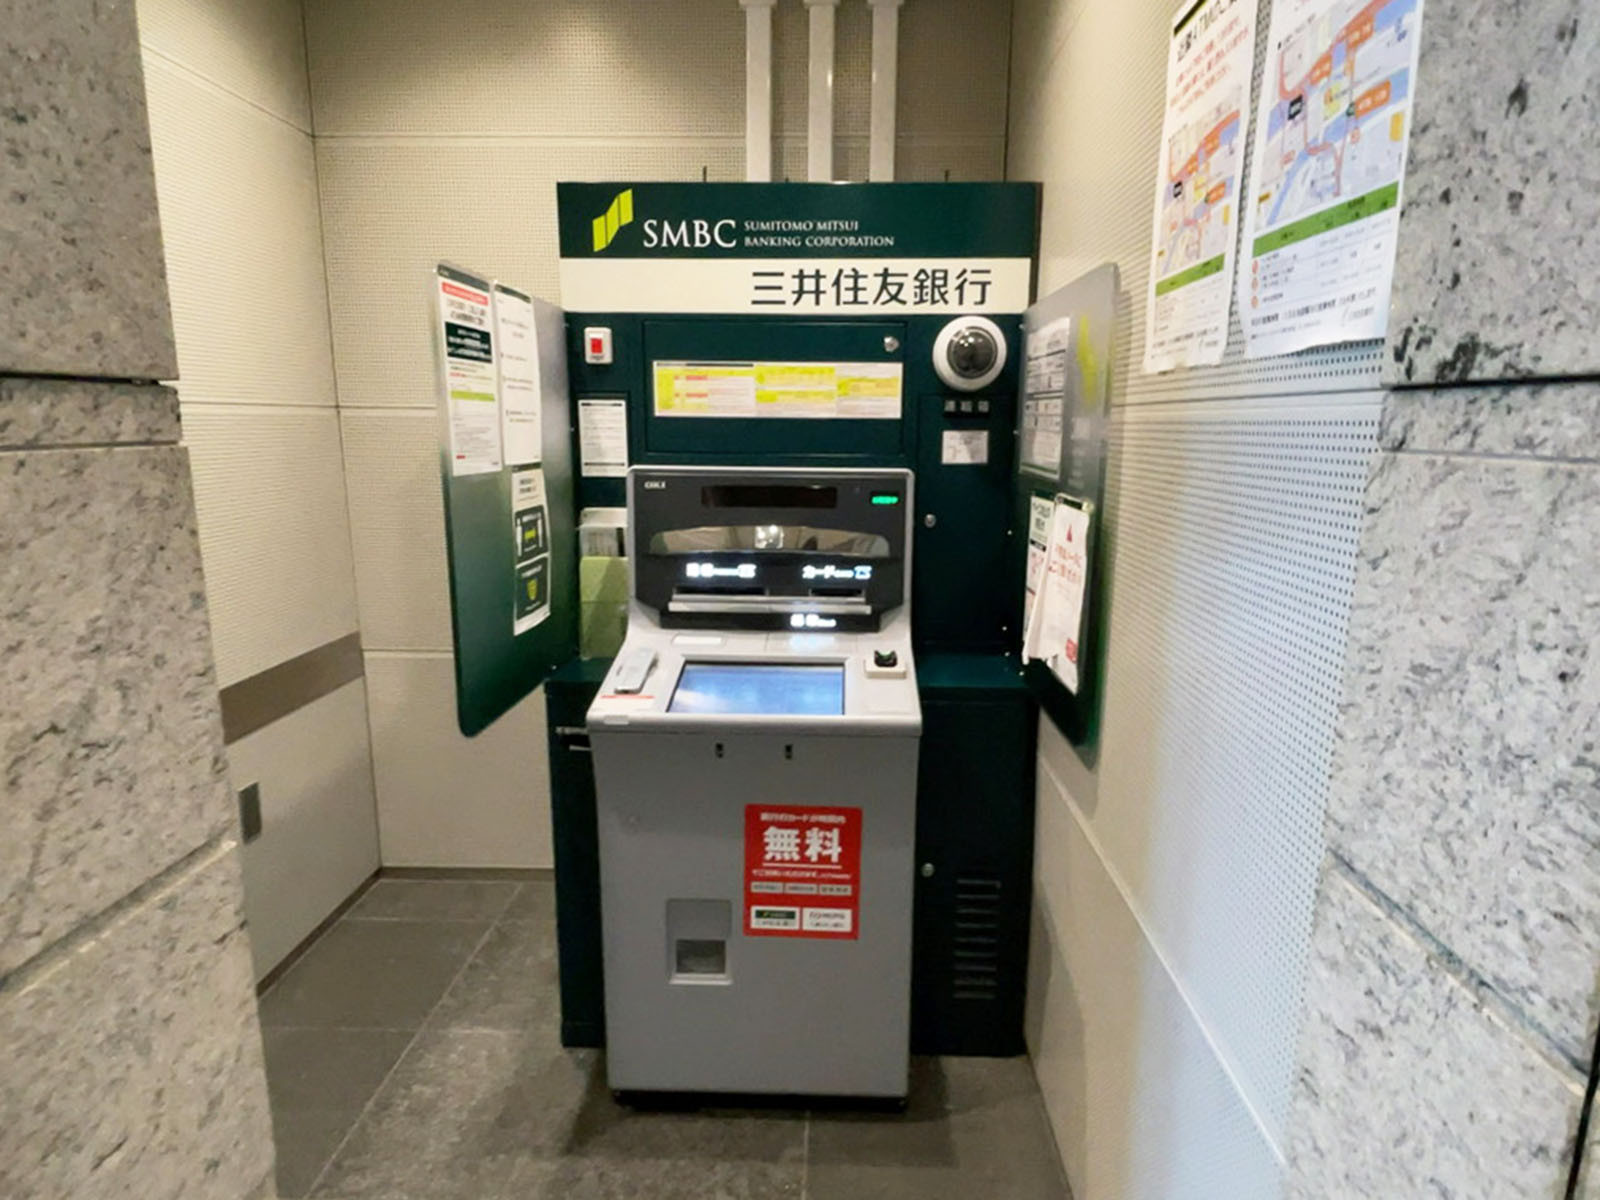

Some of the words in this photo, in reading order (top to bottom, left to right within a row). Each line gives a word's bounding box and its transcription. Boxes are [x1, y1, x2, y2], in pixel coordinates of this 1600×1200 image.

[643, 219, 737, 249] SMBC
[744, 220, 813, 232] SUMITOMO
[816, 220, 859, 232] MITSUI
[744, 235, 802, 247] BANKING
[805, 235, 895, 247] CORPORATION
[751, 268, 992, 306] 三井住友銀行
[763, 826, 842, 862] 無料
